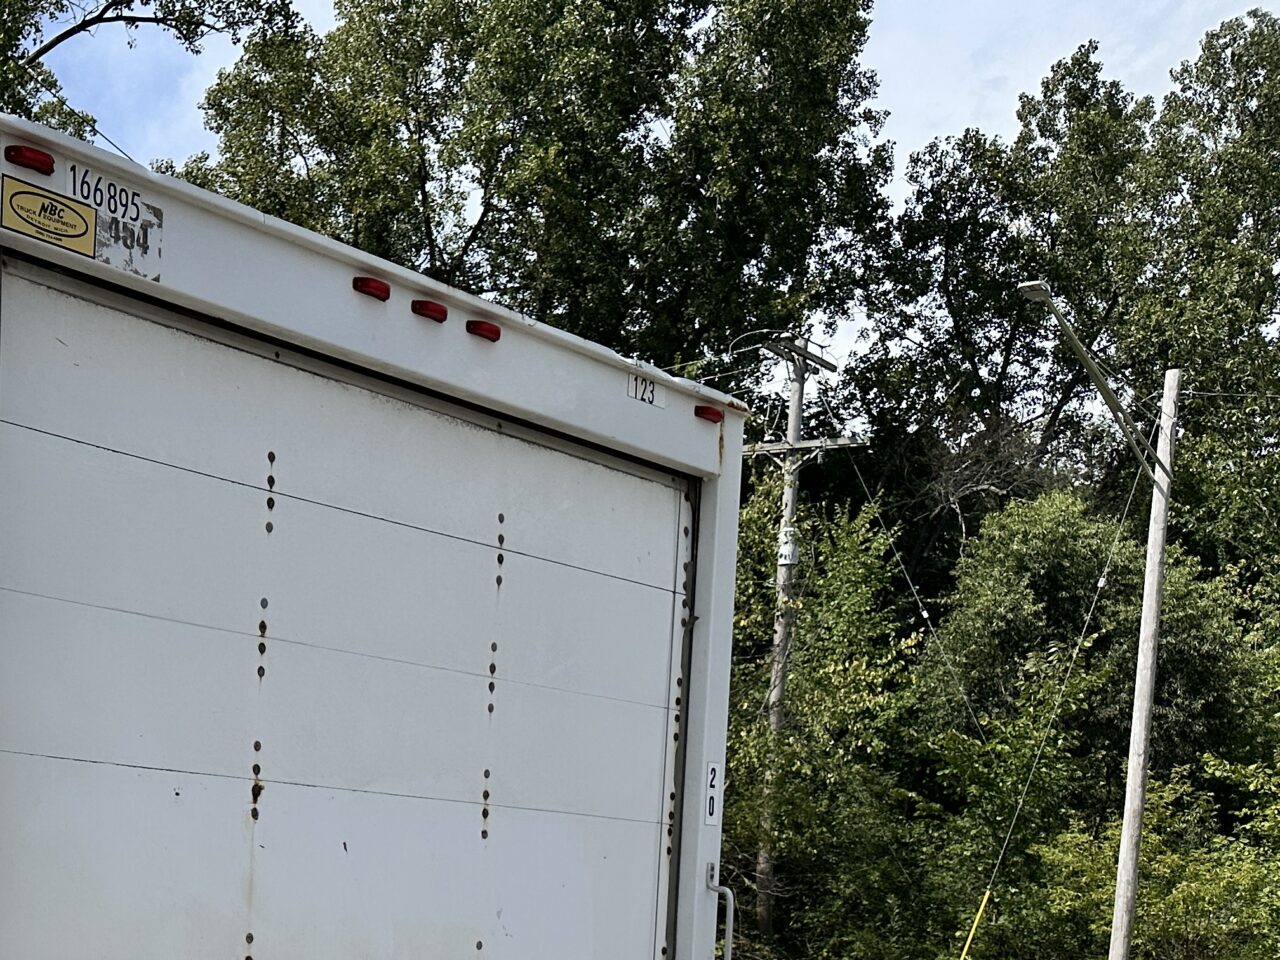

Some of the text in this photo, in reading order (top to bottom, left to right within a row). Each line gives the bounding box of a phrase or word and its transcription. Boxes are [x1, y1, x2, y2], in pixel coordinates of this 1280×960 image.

[69, 164, 141, 222] 166895
[16, 204, 77, 230] TRUCK EQUIPMENT
[38, 199, 65, 219] NBC
[634, 375, 655, 404] 123
